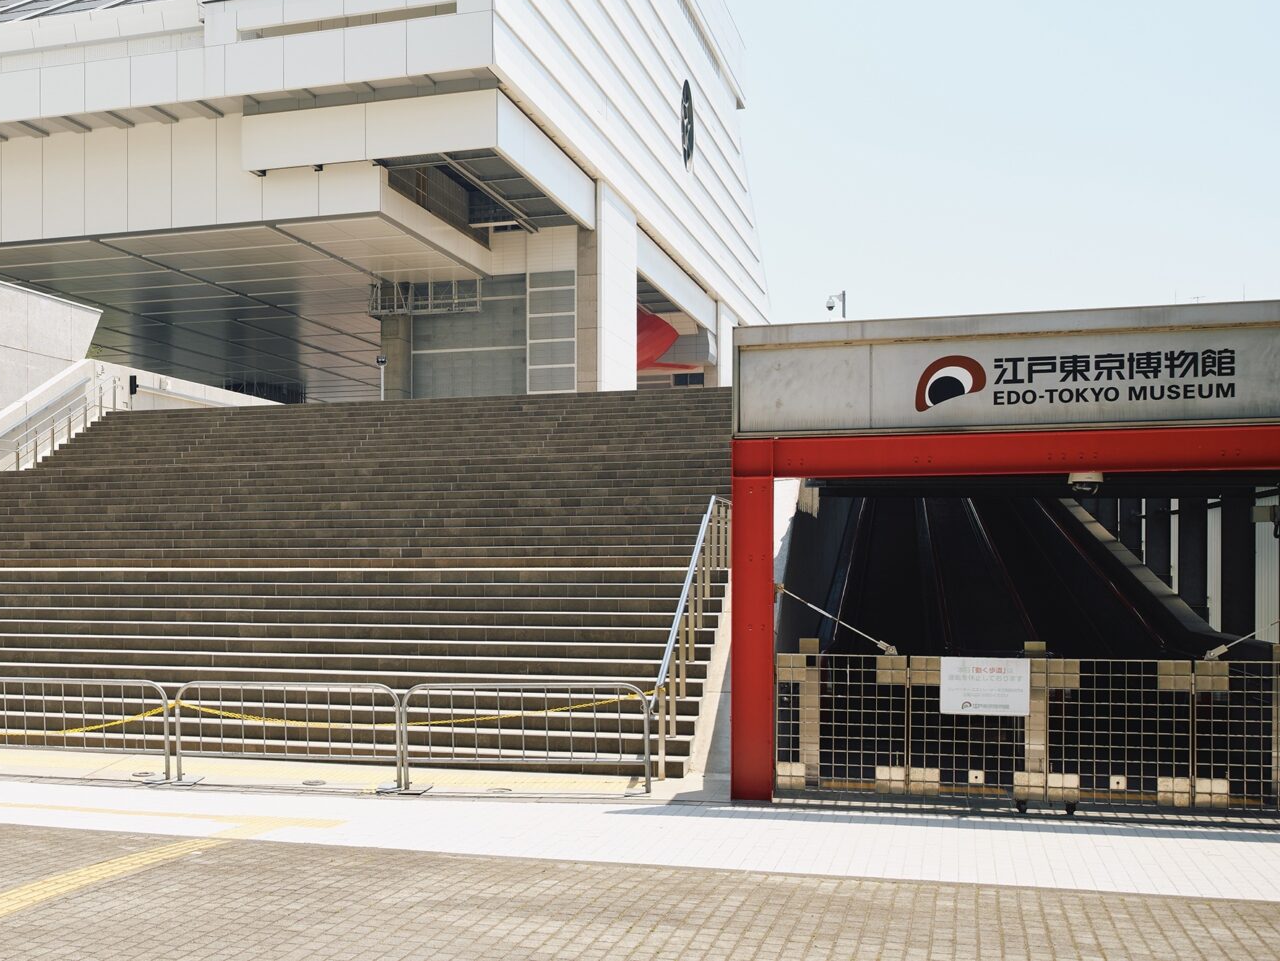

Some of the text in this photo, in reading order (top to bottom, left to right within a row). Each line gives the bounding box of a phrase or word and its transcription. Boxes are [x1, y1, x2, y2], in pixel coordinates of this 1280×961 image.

[993, 348, 1236, 385] 江戸東京博物館
[993, 382, 1236, 406] EDO-TOKYO MUSEUM
